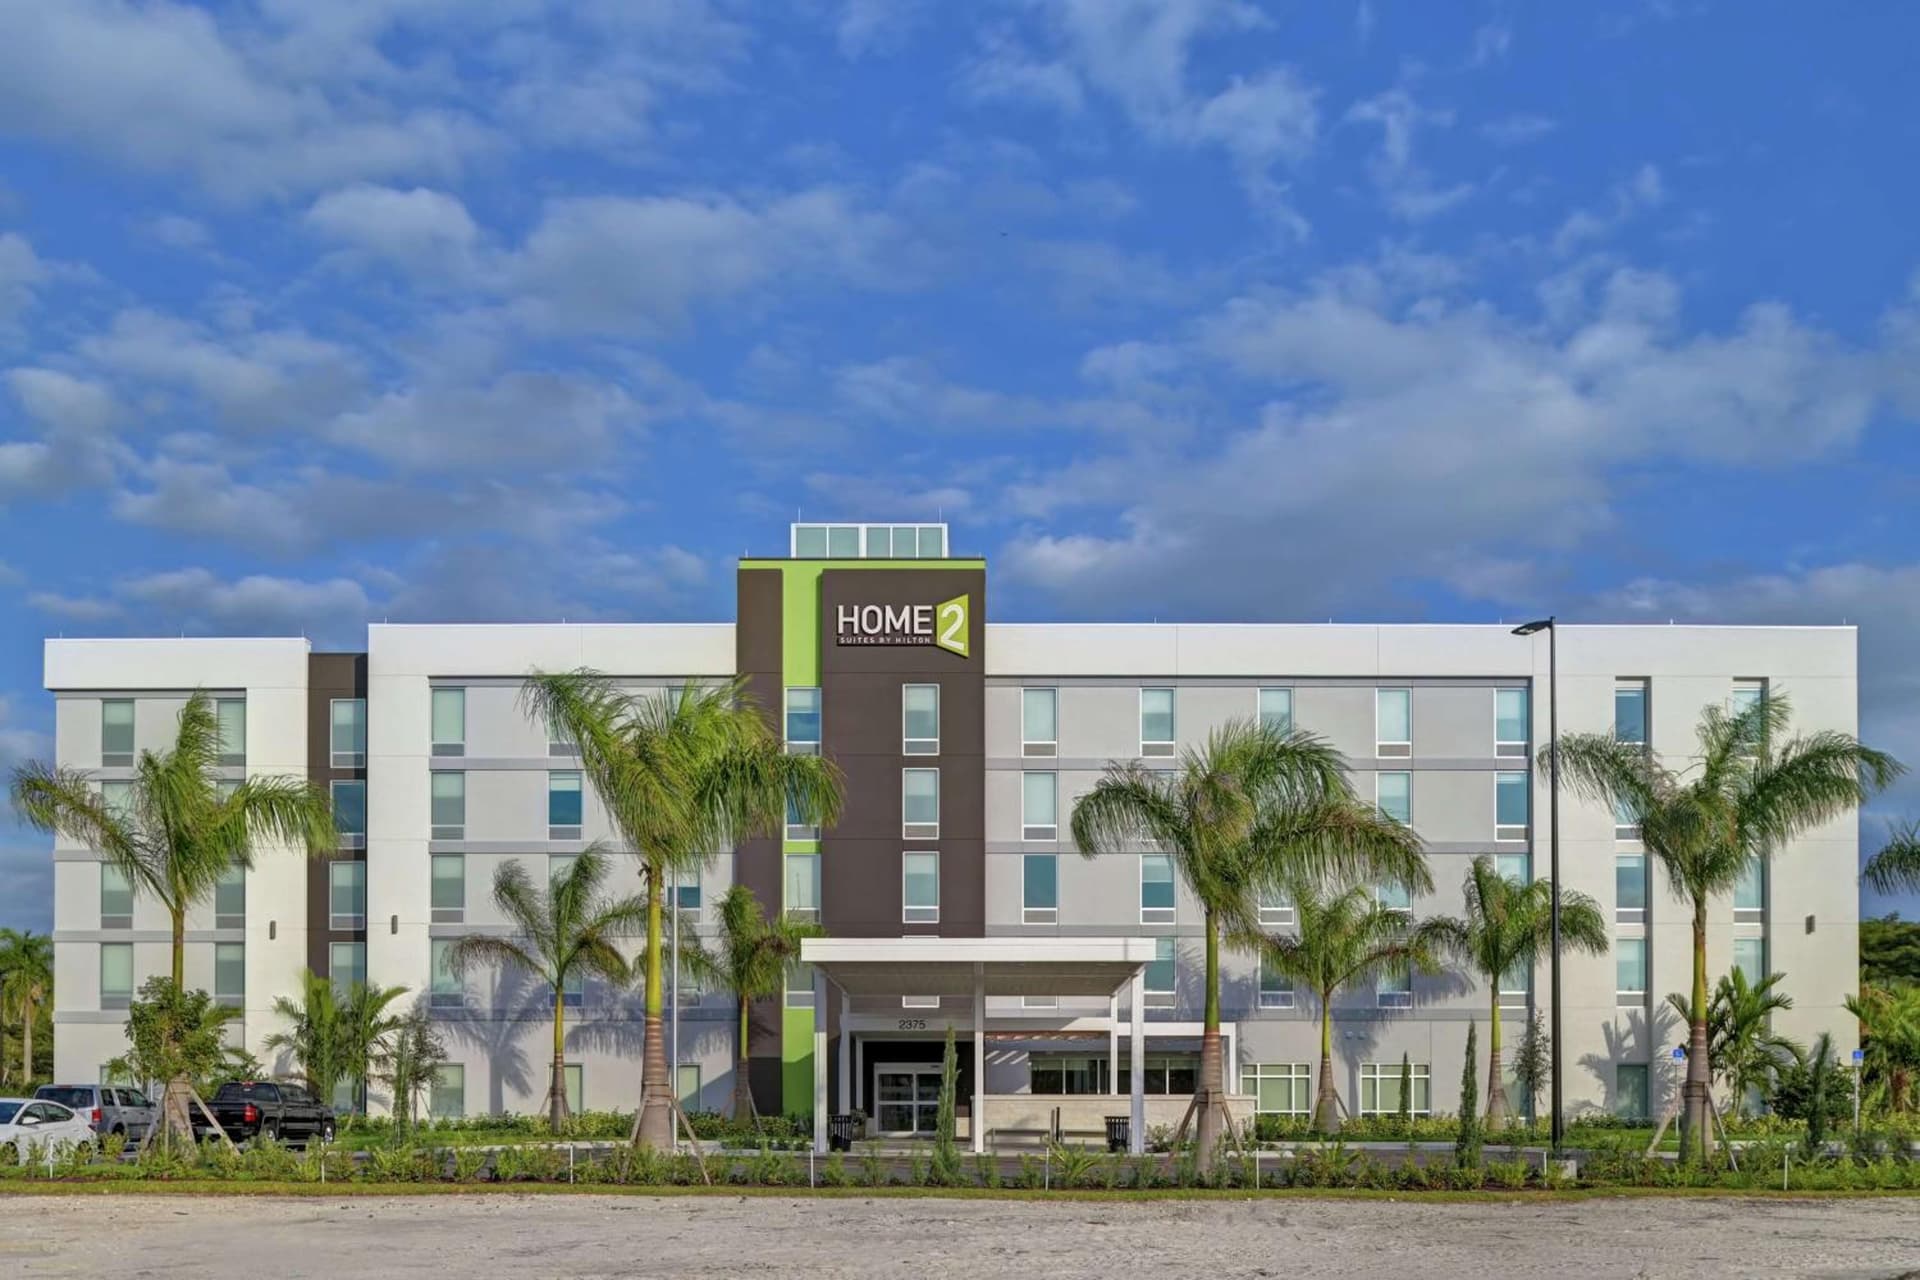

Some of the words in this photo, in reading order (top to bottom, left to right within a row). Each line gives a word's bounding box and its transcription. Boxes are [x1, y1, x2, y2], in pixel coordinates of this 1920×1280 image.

[838, 605, 933, 634] HOME
[941, 604, 965, 650] 2
[898, 1019, 926, 1030] 2375
